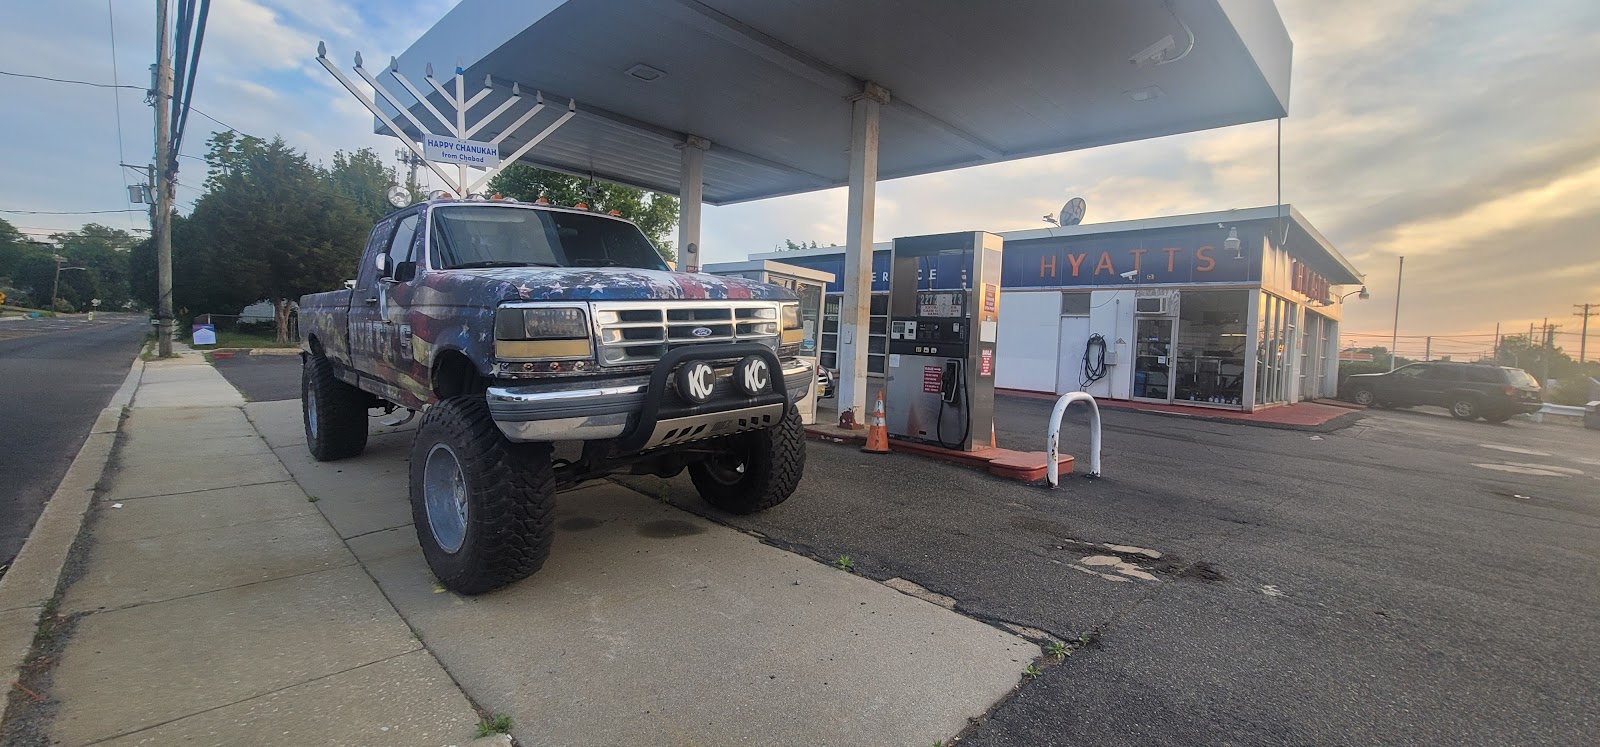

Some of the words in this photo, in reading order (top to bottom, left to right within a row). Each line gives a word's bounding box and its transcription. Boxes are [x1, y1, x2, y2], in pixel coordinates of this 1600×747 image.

[428, 139, 454, 149] HAPPY
[456, 143, 497, 156] CHANUKAH
[442, 151, 458, 160] from
[460, 153, 484, 163] Chabad
[1040, 245, 1216, 278] HYATTS
[688, 364, 713, 399] KC
[744, 360, 767, 391] KC
